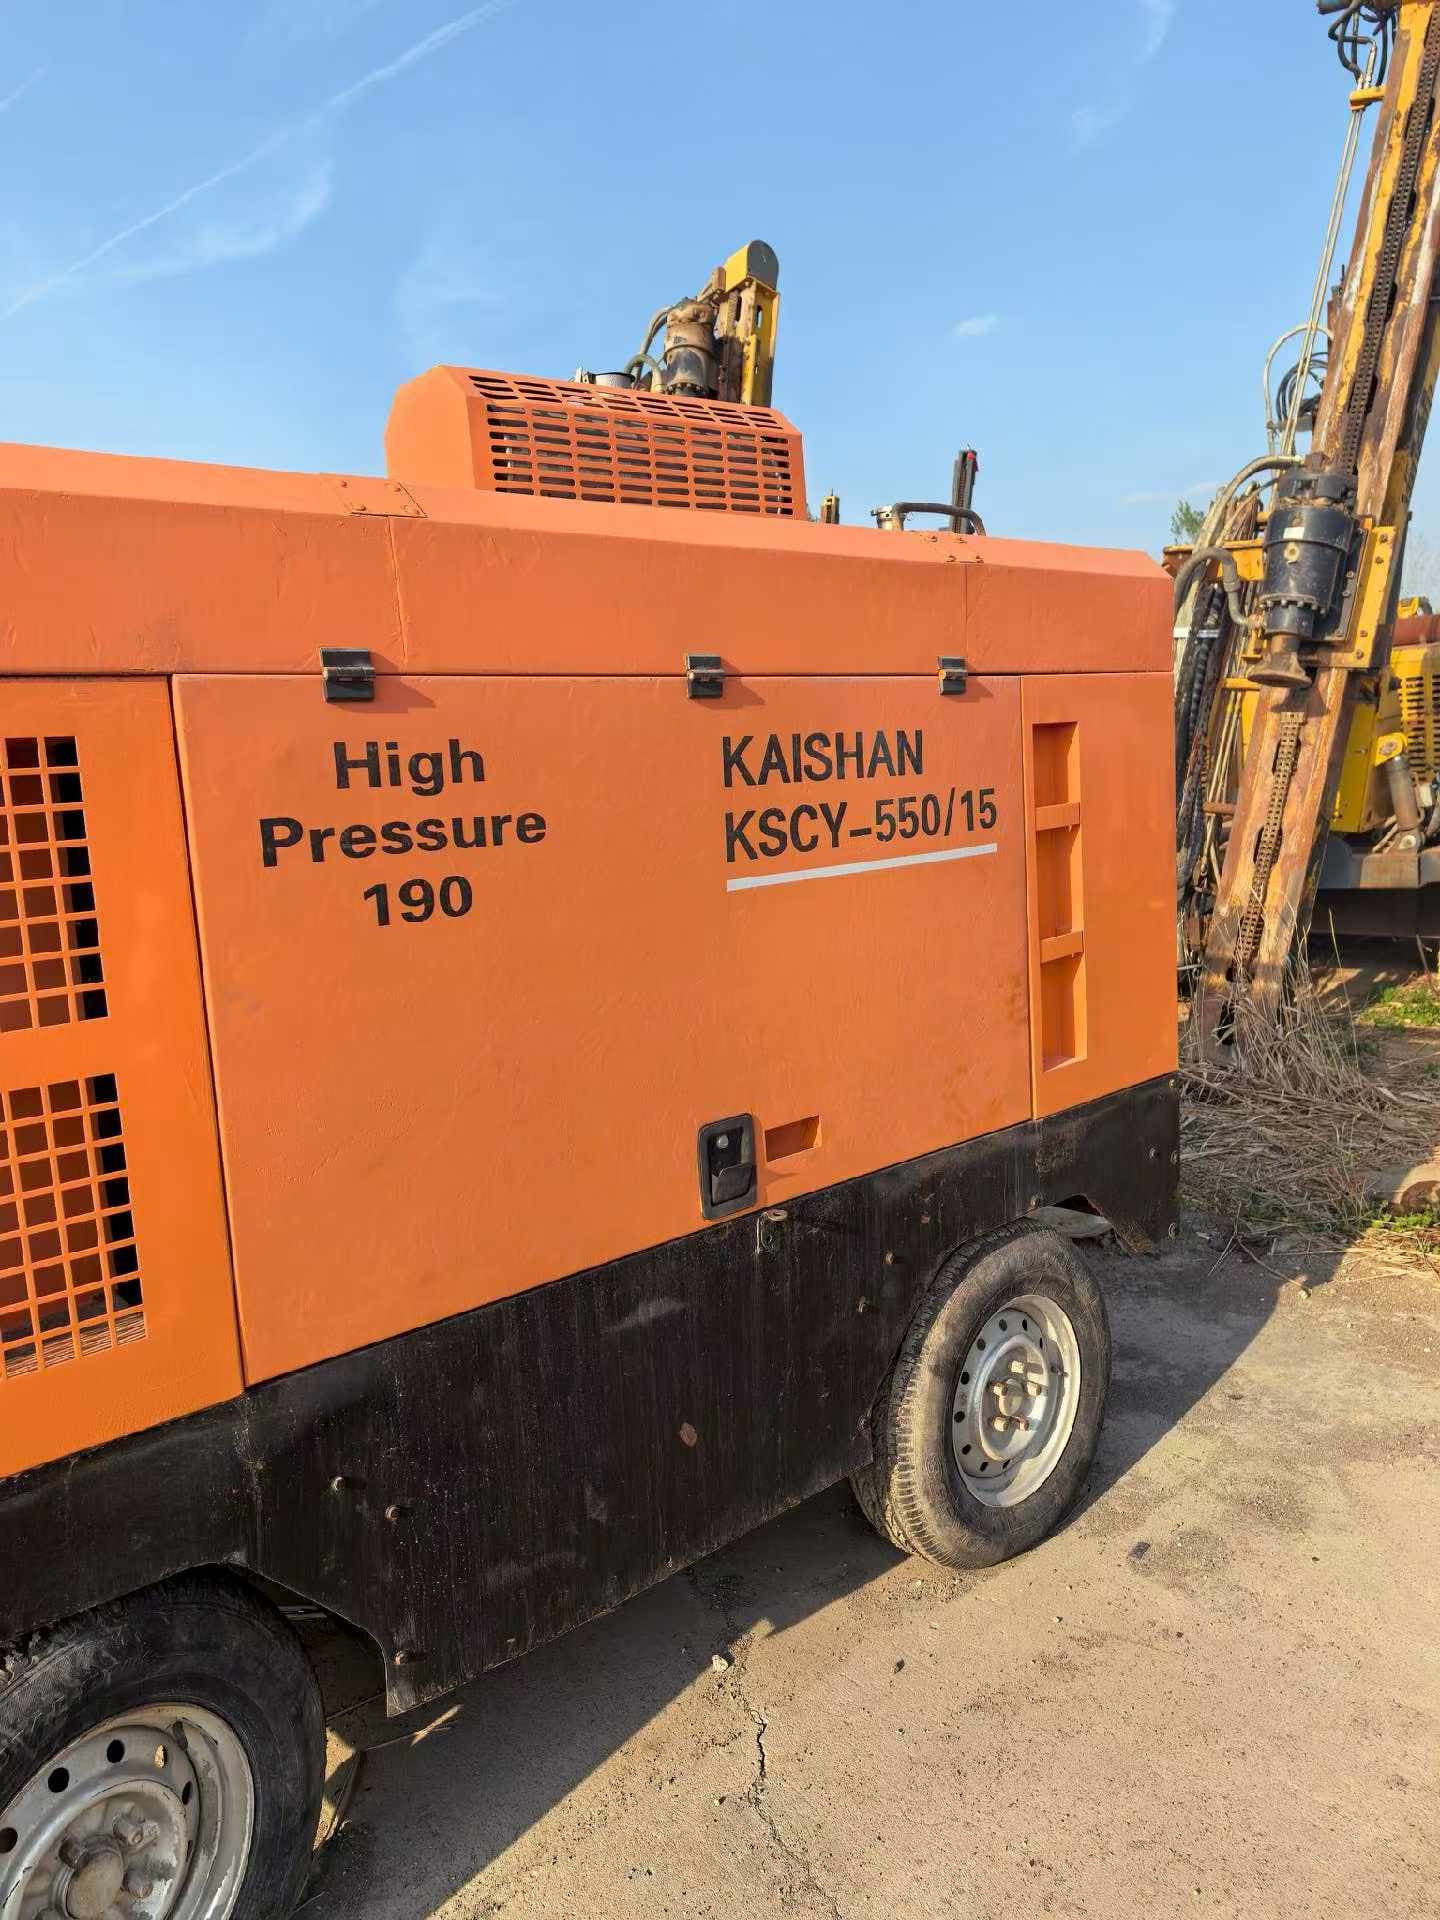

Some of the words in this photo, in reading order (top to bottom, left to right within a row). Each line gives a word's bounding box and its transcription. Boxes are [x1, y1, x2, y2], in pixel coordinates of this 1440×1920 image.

[333, 738, 485, 797] High
[722, 729, 923, 788] KAISHAN
[259, 812, 547, 868] Pressure
[724, 787, 997, 863] KSCY-550/15
[363, 875, 473, 927] 190
